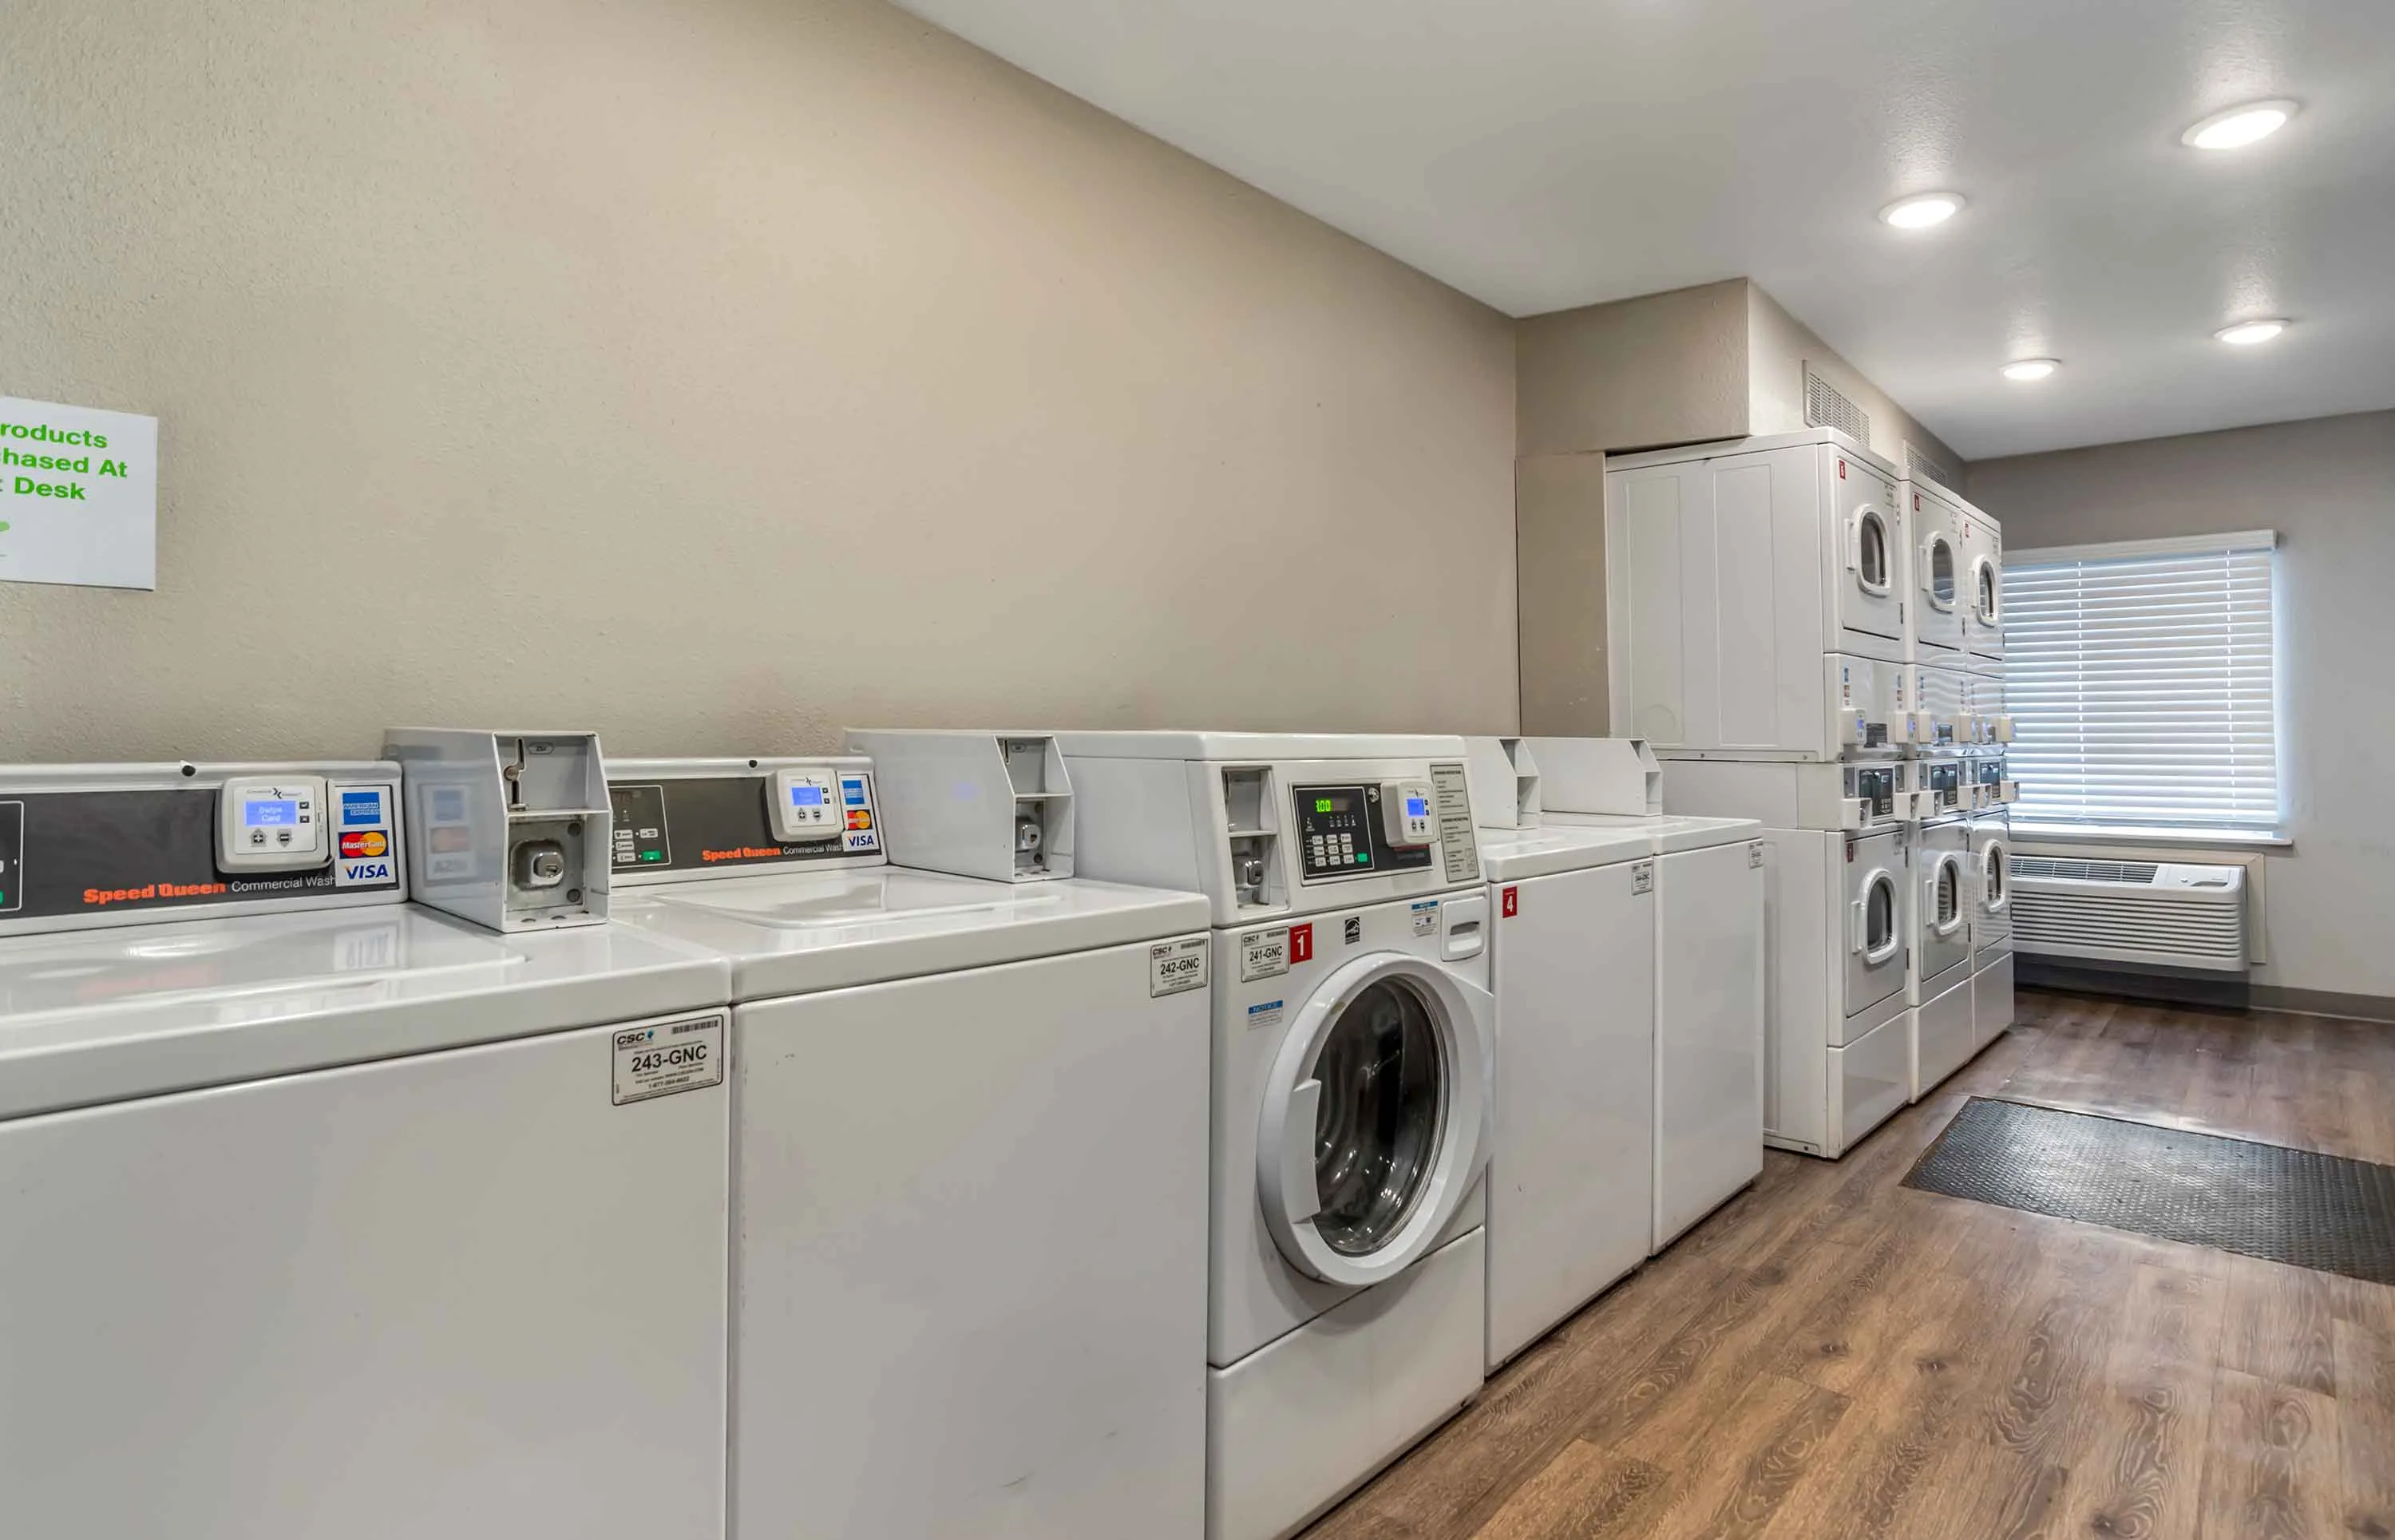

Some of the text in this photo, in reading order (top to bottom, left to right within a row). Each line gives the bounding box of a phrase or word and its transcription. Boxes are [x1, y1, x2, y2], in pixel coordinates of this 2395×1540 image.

[0, 447, 128, 477] hased At
[14, 476, 86, 501] Desk
[848, 835, 874, 846] VISA
[703, 848, 741, 861] Speed
[743, 846, 781, 857] Queen
[783, 844, 824, 855] Commercial
[345, 864, 389, 880] VISA
[83, 885, 155, 905] Speed
[159, 882, 226, 898] Queen
[232, 877, 303, 893] Commercial
[1506, 895, 1514, 913] 4
[1249, 945, 1283, 962] 241-GNC
[1296, 934, 1304, 956] 1
[1160, 957, 1200, 976] 242-GNC
[616, 1032, 645, 1045] CSC
[631, 1045, 707, 1073] 243-GNC
